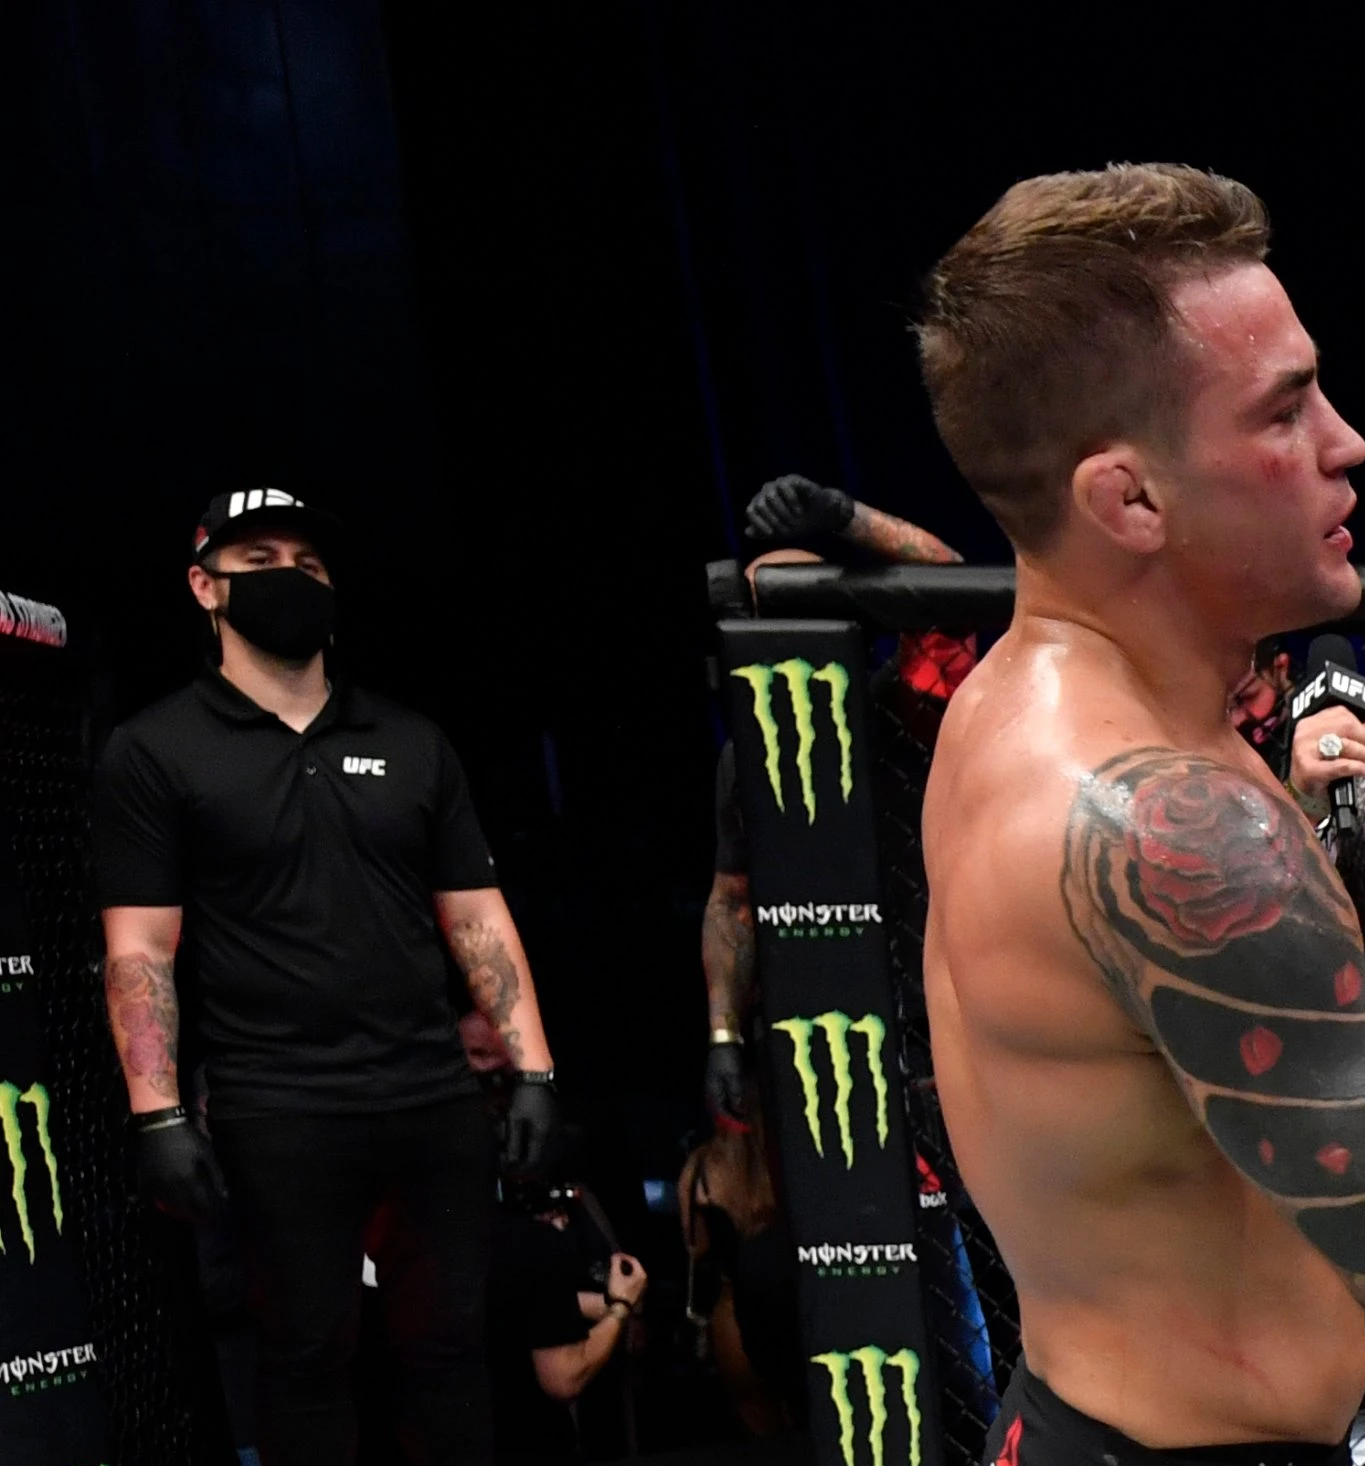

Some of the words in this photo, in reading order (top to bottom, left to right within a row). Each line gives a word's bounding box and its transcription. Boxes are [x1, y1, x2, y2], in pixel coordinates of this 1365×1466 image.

[1292, 671, 1326, 719] UFC
[343, 756, 386, 776] UFC
[757, 901, 882, 927] MONSTER
[797, 1242, 917, 1266] MONSTER
